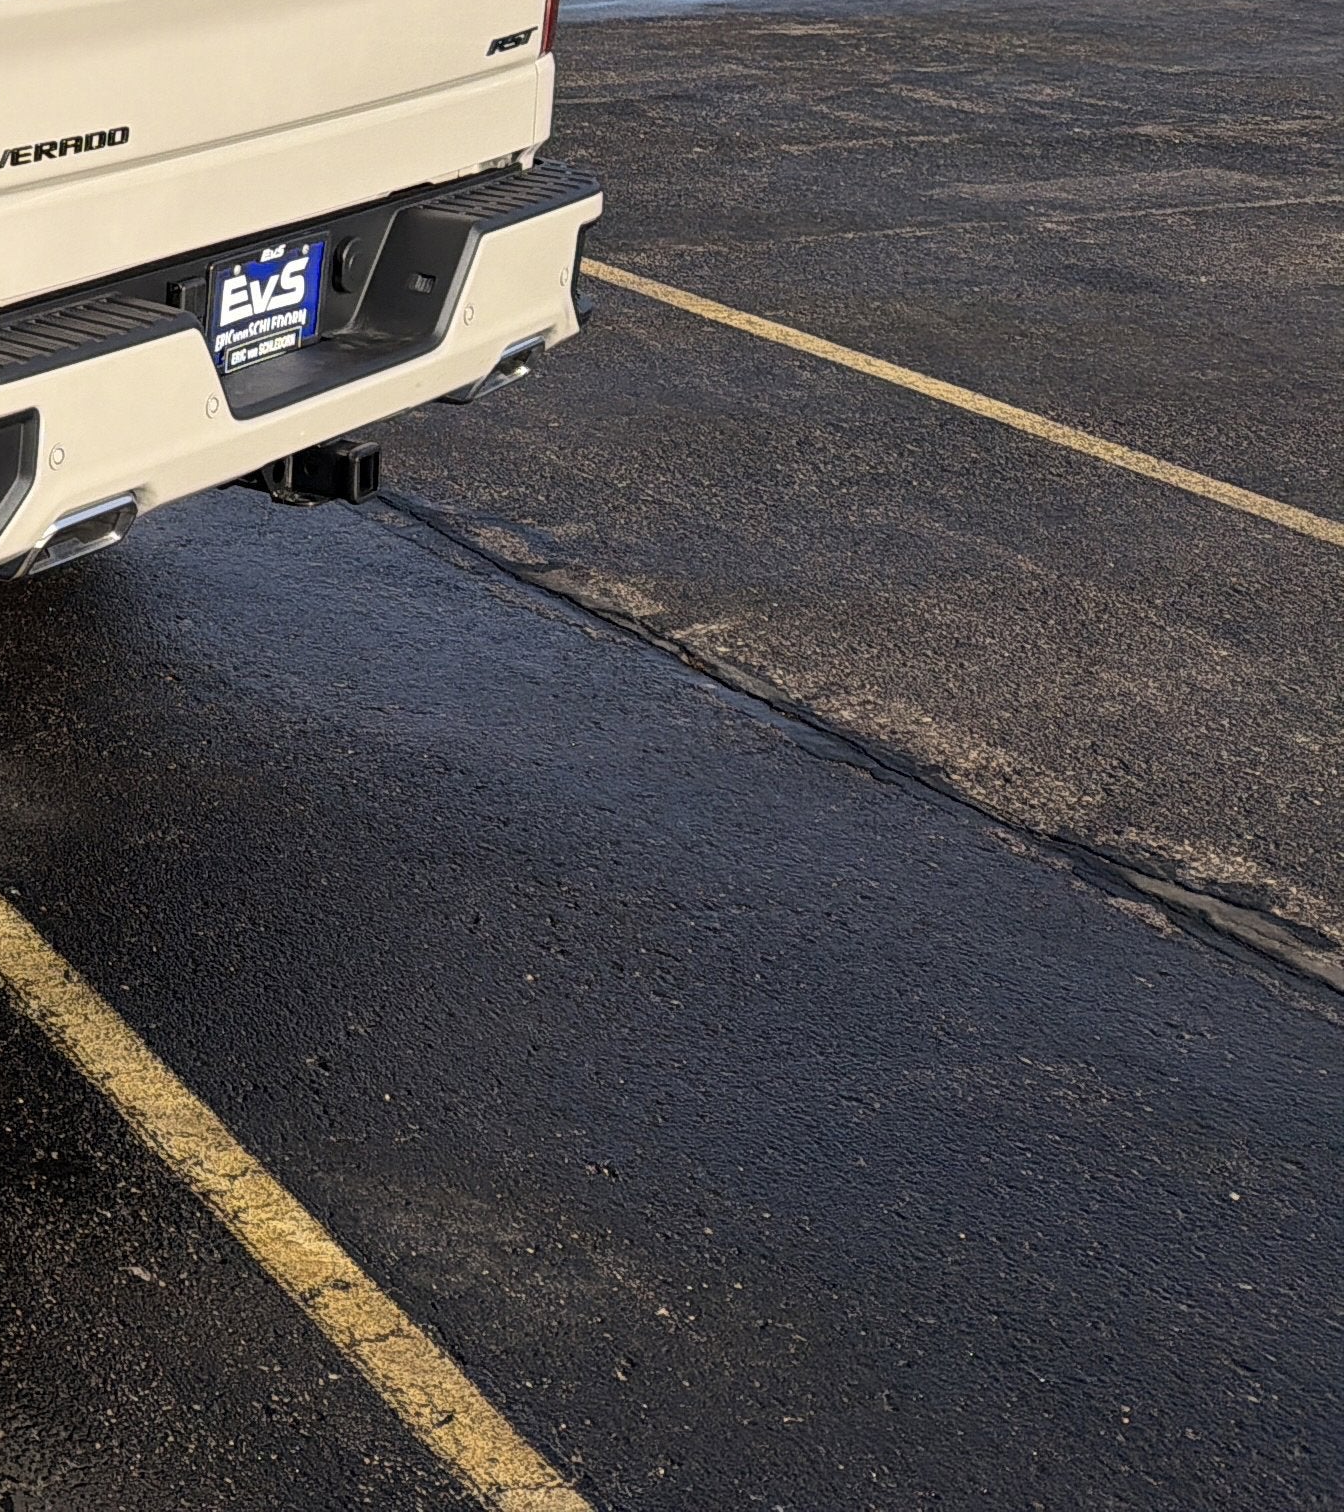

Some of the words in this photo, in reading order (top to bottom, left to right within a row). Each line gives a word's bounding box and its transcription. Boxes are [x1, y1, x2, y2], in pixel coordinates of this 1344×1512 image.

[485, 25, 539, 56] RST
[214, 329, 235, 352] ERIC
[230, 348, 247, 366] ERIC
